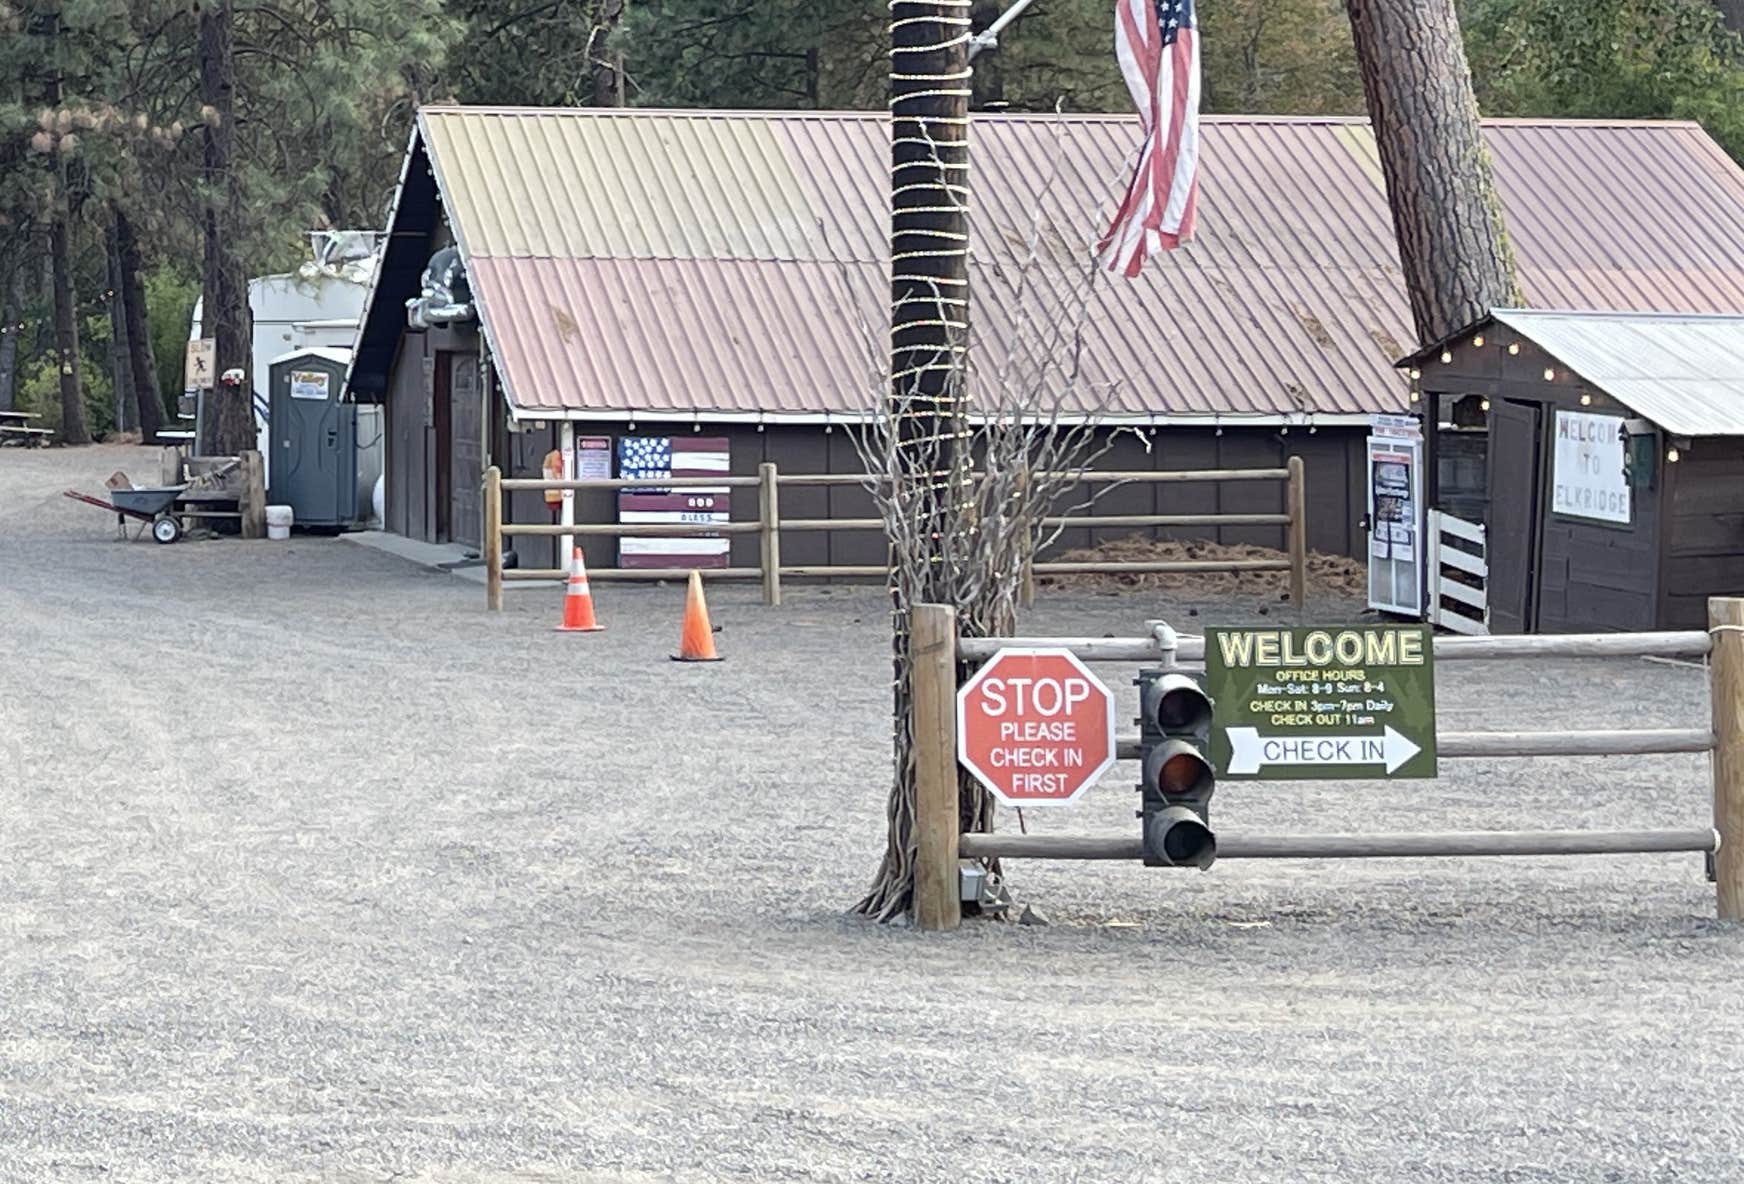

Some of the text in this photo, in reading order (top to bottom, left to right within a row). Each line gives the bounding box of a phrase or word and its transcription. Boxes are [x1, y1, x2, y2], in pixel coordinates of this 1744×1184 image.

[1559, 418, 1617, 444] WELCOM
[1582, 453, 1601, 475] TO
[1555, 484, 1627, 515] ELKRIDGE
[1217, 630, 1424, 666] WELCOME
[1276, 669, 1366, 682] OFFICE HOURS
[980, 677, 1090, 716] STOP
[1250, 699, 1394, 713] CHECK IN 3pm-7pm Daily
[1271, 714, 1375, 726] CHECK OUT 11am
[1001, 721, 1076, 742] PLEASE
[990, 747, 1083, 767] CHECK IN
[1263, 740, 1385, 761] CHECK IN
[1012, 773, 1068, 793] FIRST
